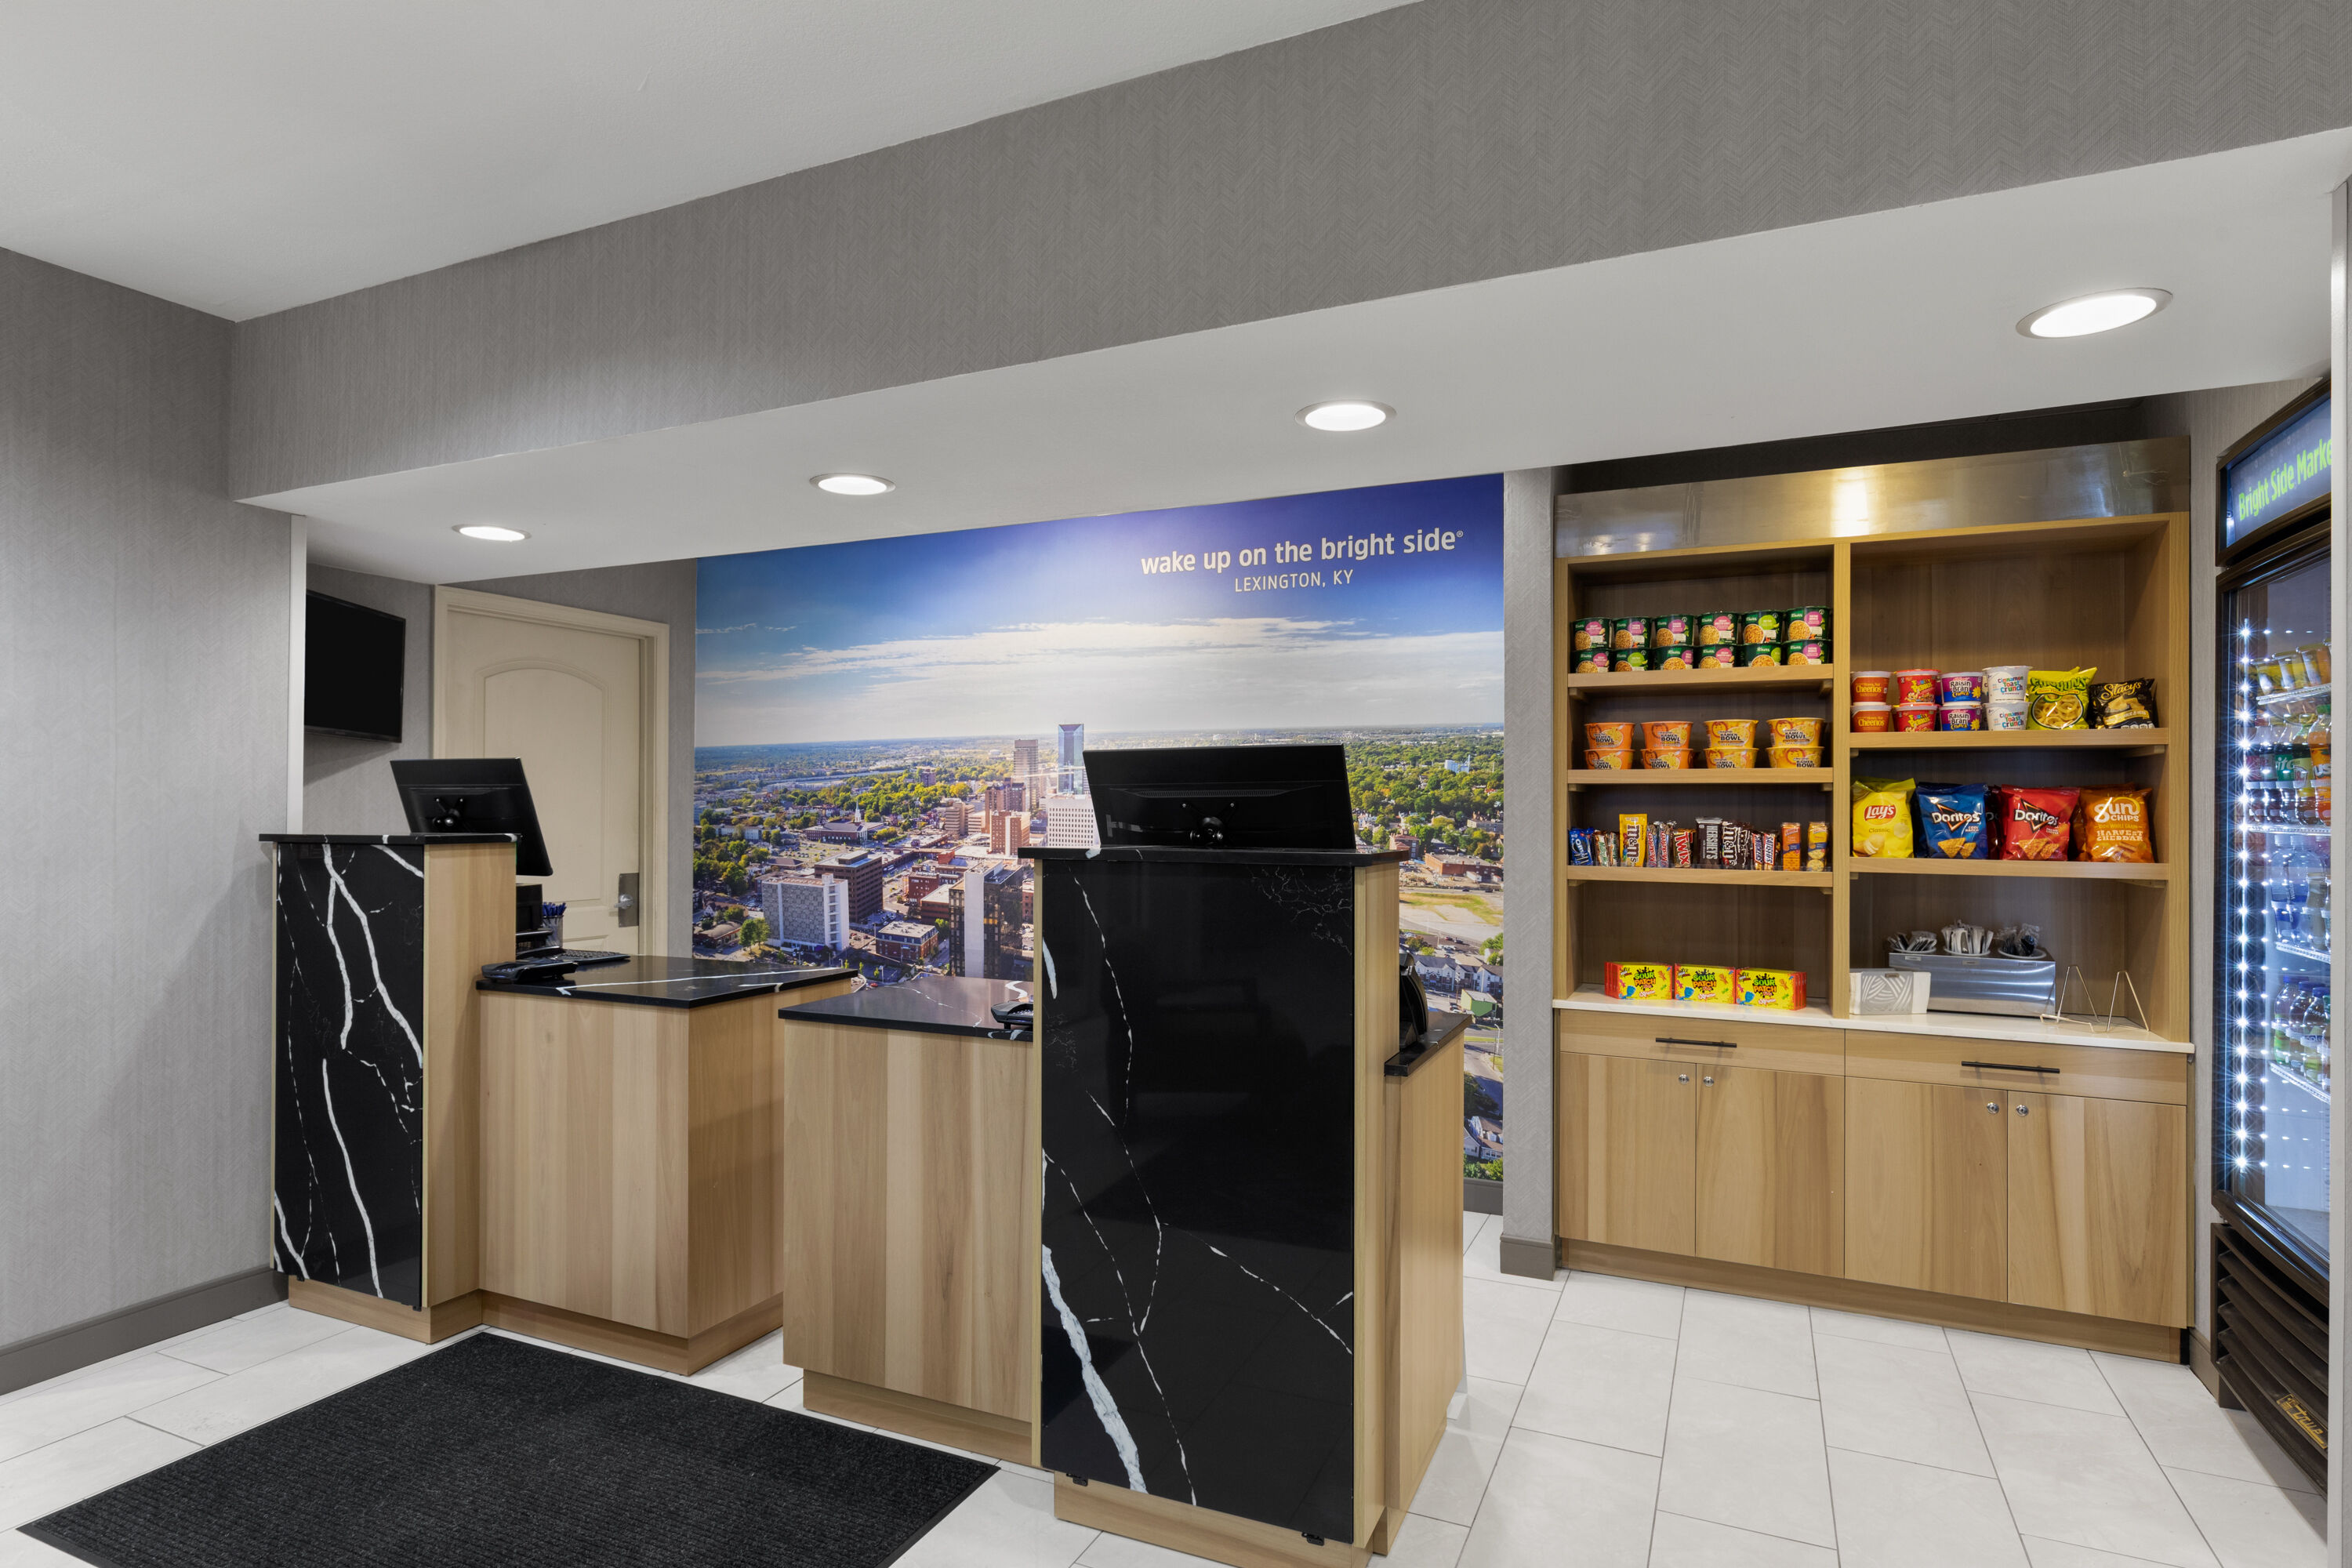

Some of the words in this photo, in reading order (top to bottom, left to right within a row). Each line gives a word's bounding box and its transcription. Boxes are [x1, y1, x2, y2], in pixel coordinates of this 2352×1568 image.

[2239, 478, 2270, 521] Bright
[2270, 463, 2294, 501] Side
[2296, 439, 2332, 485] Marke
[1141, 550, 1196, 575] wake
[1203, 551, 1231, 574] up
[1239, 547, 1267, 566] on
[1275, 539, 1312, 564] the
[1321, 532, 1395, 562] bright
[1234, 572, 1327, 593] LEXINGTON,
[1333, 569, 1353, 585] KY
[2100, 681, 2143, 700] Stacy's
[1858, 718, 1885, 727] Cheerios
[1865, 804, 1895, 820] Lay's
[1932, 811, 1980, 824] Doritos
[2015, 809, 2059, 826] Doritos
[1675, 831, 1690, 865] TWIX
